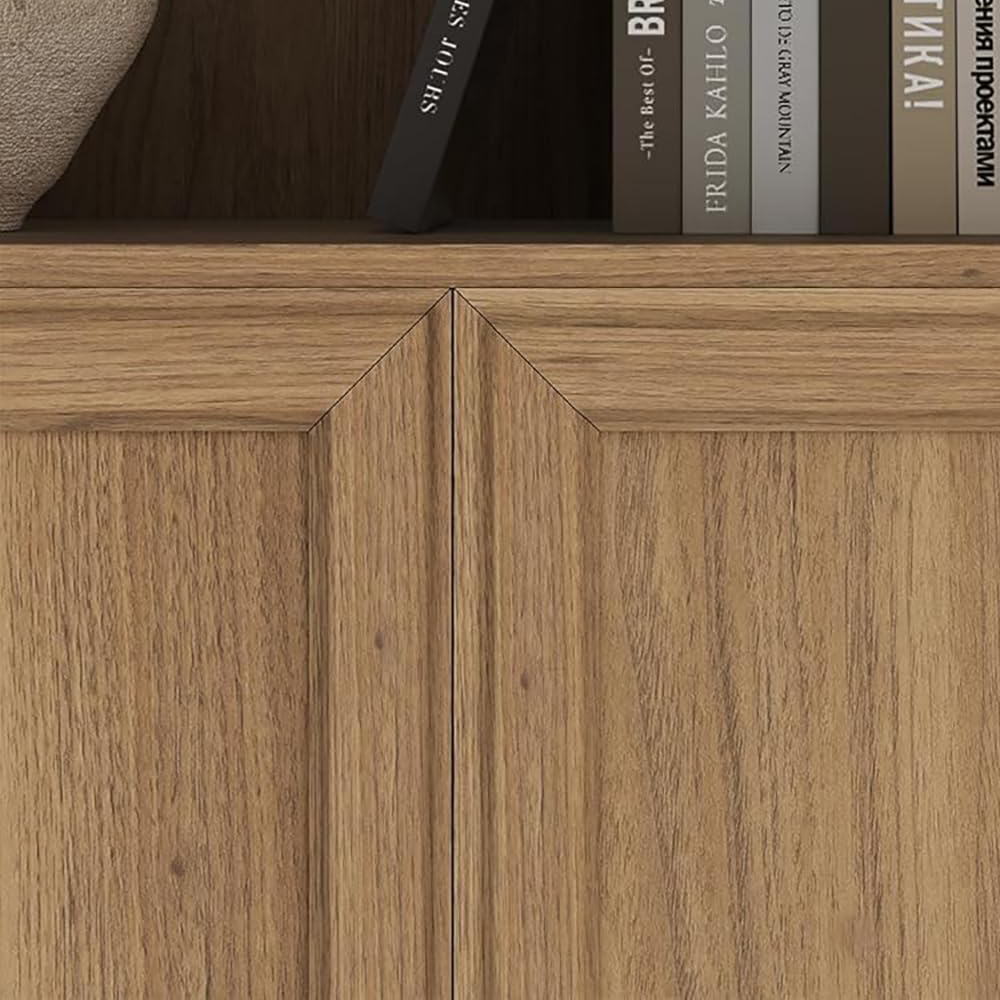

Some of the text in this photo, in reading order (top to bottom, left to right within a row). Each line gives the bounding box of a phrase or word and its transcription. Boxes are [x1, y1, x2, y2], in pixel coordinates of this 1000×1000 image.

[638, 82, 655, 115] Best
[777, 50, 791, 88] GRAY
[704, 24, 728, 213] FRIDA KAHLO
[777, 92, 791, 175] MOUNTAIN
[970, 56, 996, 188] проектами
